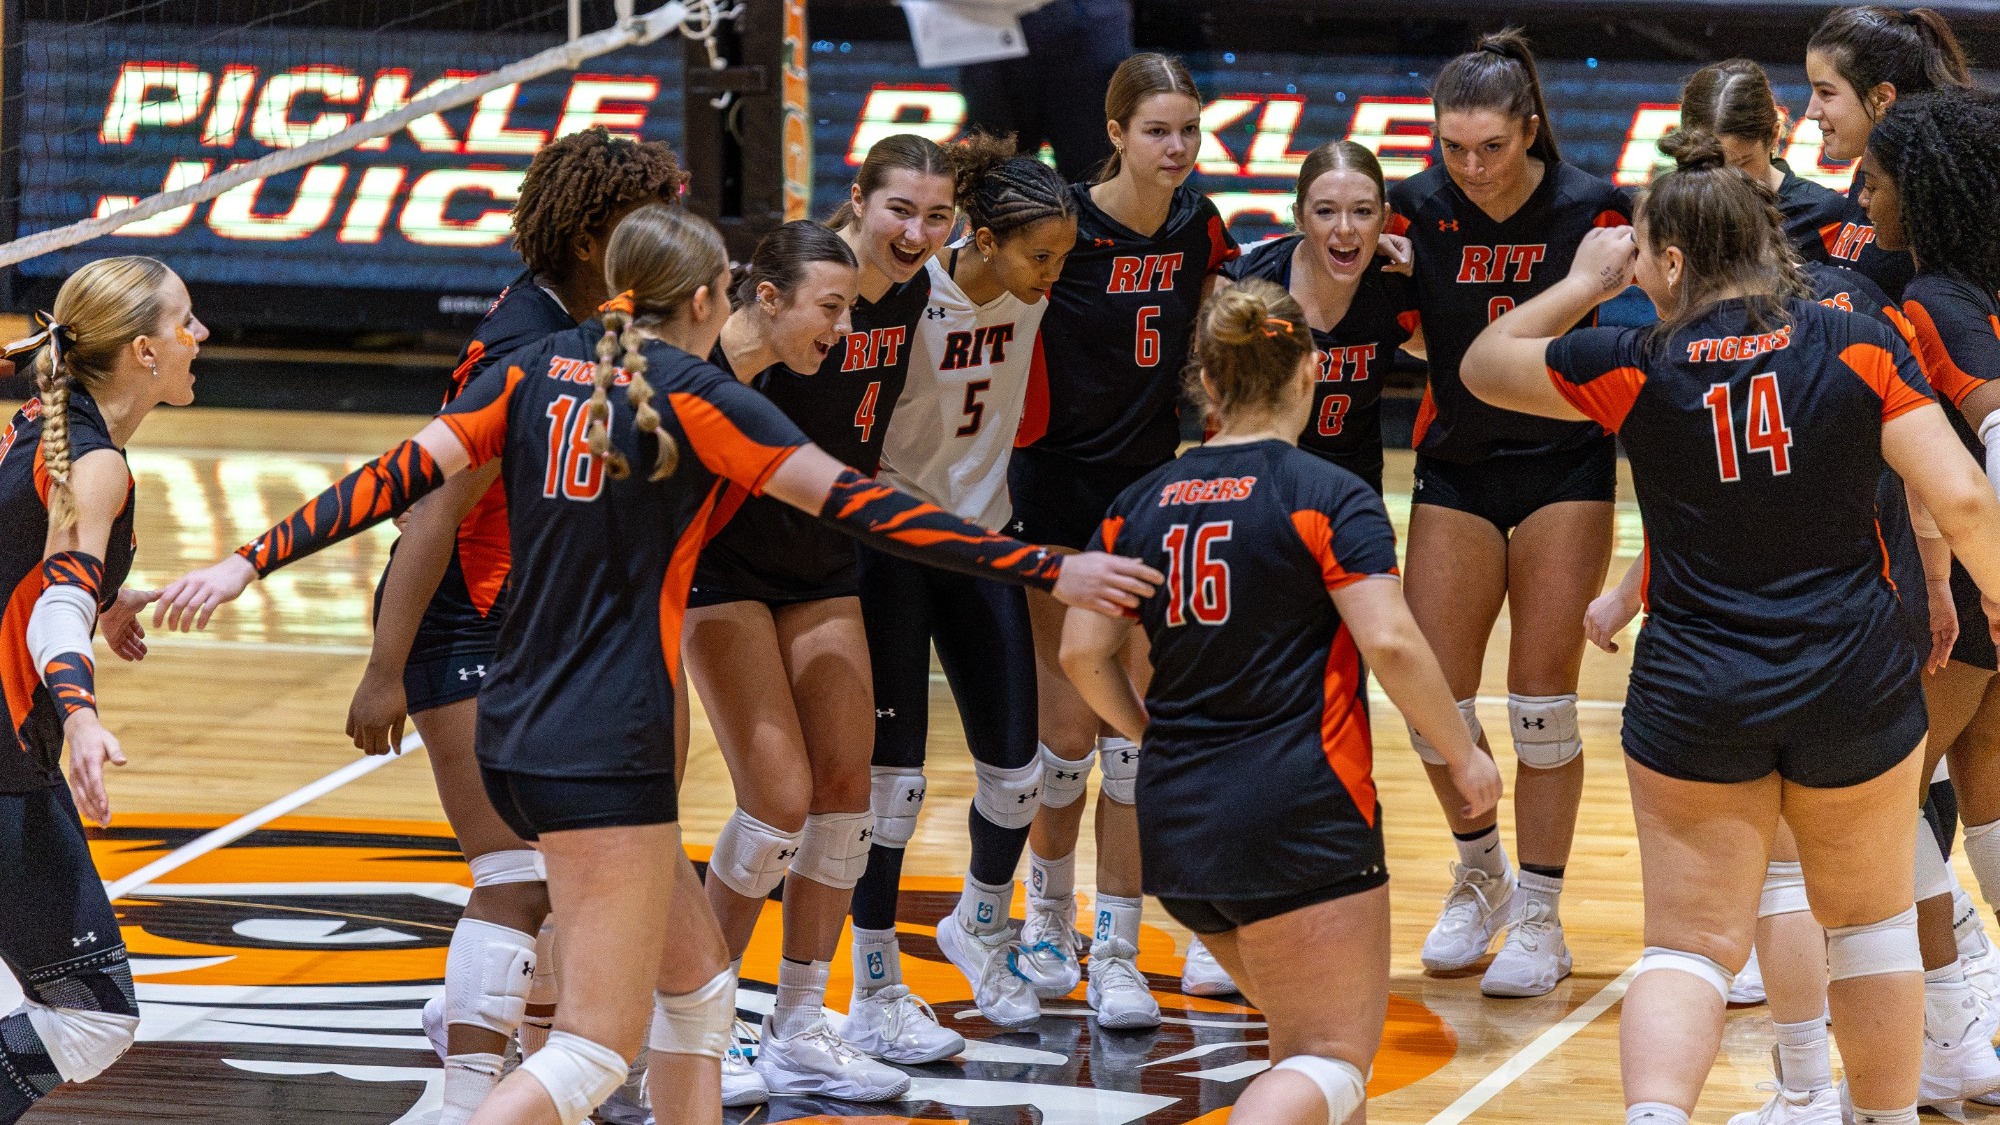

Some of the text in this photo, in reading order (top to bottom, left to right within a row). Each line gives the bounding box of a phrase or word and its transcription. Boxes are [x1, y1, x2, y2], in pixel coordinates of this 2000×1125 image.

[98, 60, 661, 155] PICKLE
[845, 83, 1436, 180] PKLE
[92, 157, 527, 248] JUIC
[1456, 244, 1546, 283] RIT
[1831, 222, 1876, 262] RIT
[1106, 252, 1184, 294] RIT
[840, 325, 906, 372] RIT
[939, 322, 1015, 371] RIT
[1135, 306, 1160, 368] 6
[1687, 325, 1790, 362] TIGERS
[547, 355, 633, 386] TIGS
[854, 381, 881, 442] 4
[955, 378, 991, 438] 5
[1318, 394, 1351, 437] 8
[1703, 371, 1793, 483] 14
[543, 394, 613, 502] 18
[1159, 476, 1257, 507] TIGERS
[1162, 520, 1233, 628] 16
